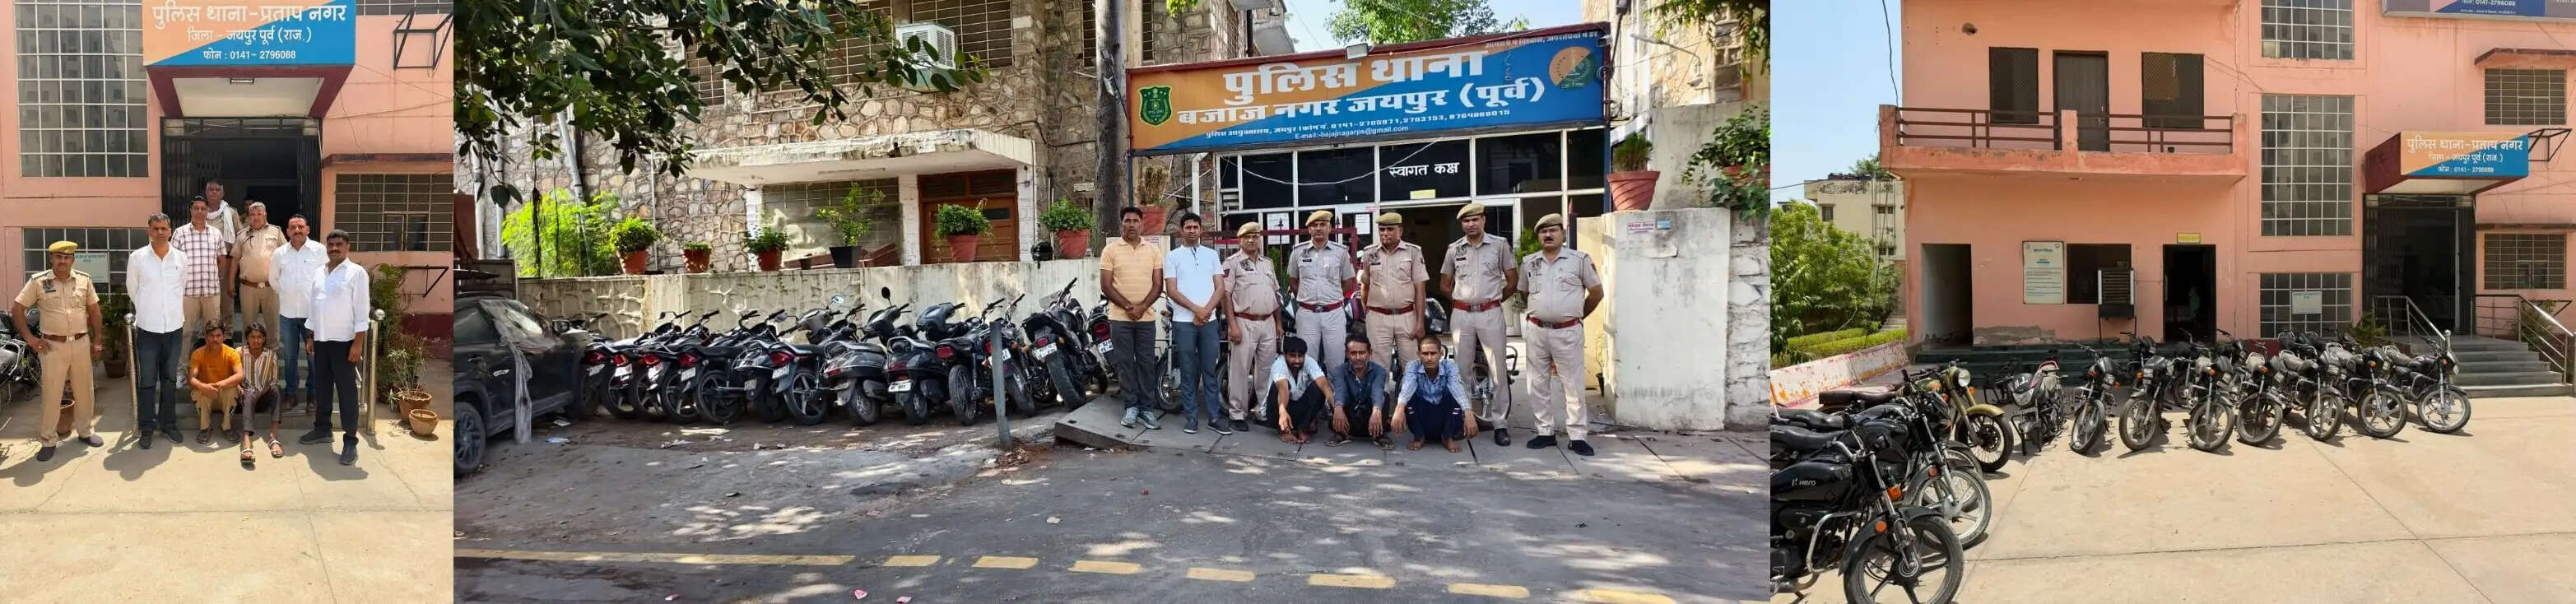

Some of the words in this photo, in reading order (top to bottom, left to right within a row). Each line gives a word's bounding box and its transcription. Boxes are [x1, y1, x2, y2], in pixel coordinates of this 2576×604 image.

[151, 1, 201, 30] पुलिस
[309, 5, 347, 21] नगर
[187, 28, 213, 42] जिला
[226, 29, 257, 45] जयपुर
[259, 26, 275, 45] पूर्व
[277, 27, 312, 43] (राज.)
[202, 48, 221, 60] फोन
[259, 50, 296, 59] 2796088
[1223, 59, 1362, 105] पुलिस
[1371, 49, 1489, 84] थाना
[1177, 105, 1269, 125] बजाज
[1273, 99, 1341, 118] नगर
[1346, 88, 1448, 114] जयपुर
[1459, 77, 1546, 109] (पूर्व)
[2407, 134, 2437, 153] पुलिस
[2500, 140, 2523, 151] नगर
[2452, 154, 2470, 164] जयपुर
[2471, 151, 2481, 164] पूर्व
[1389, 165, 1430, 178] स्वागत
[1434, 162, 1460, 174] कक्ष
